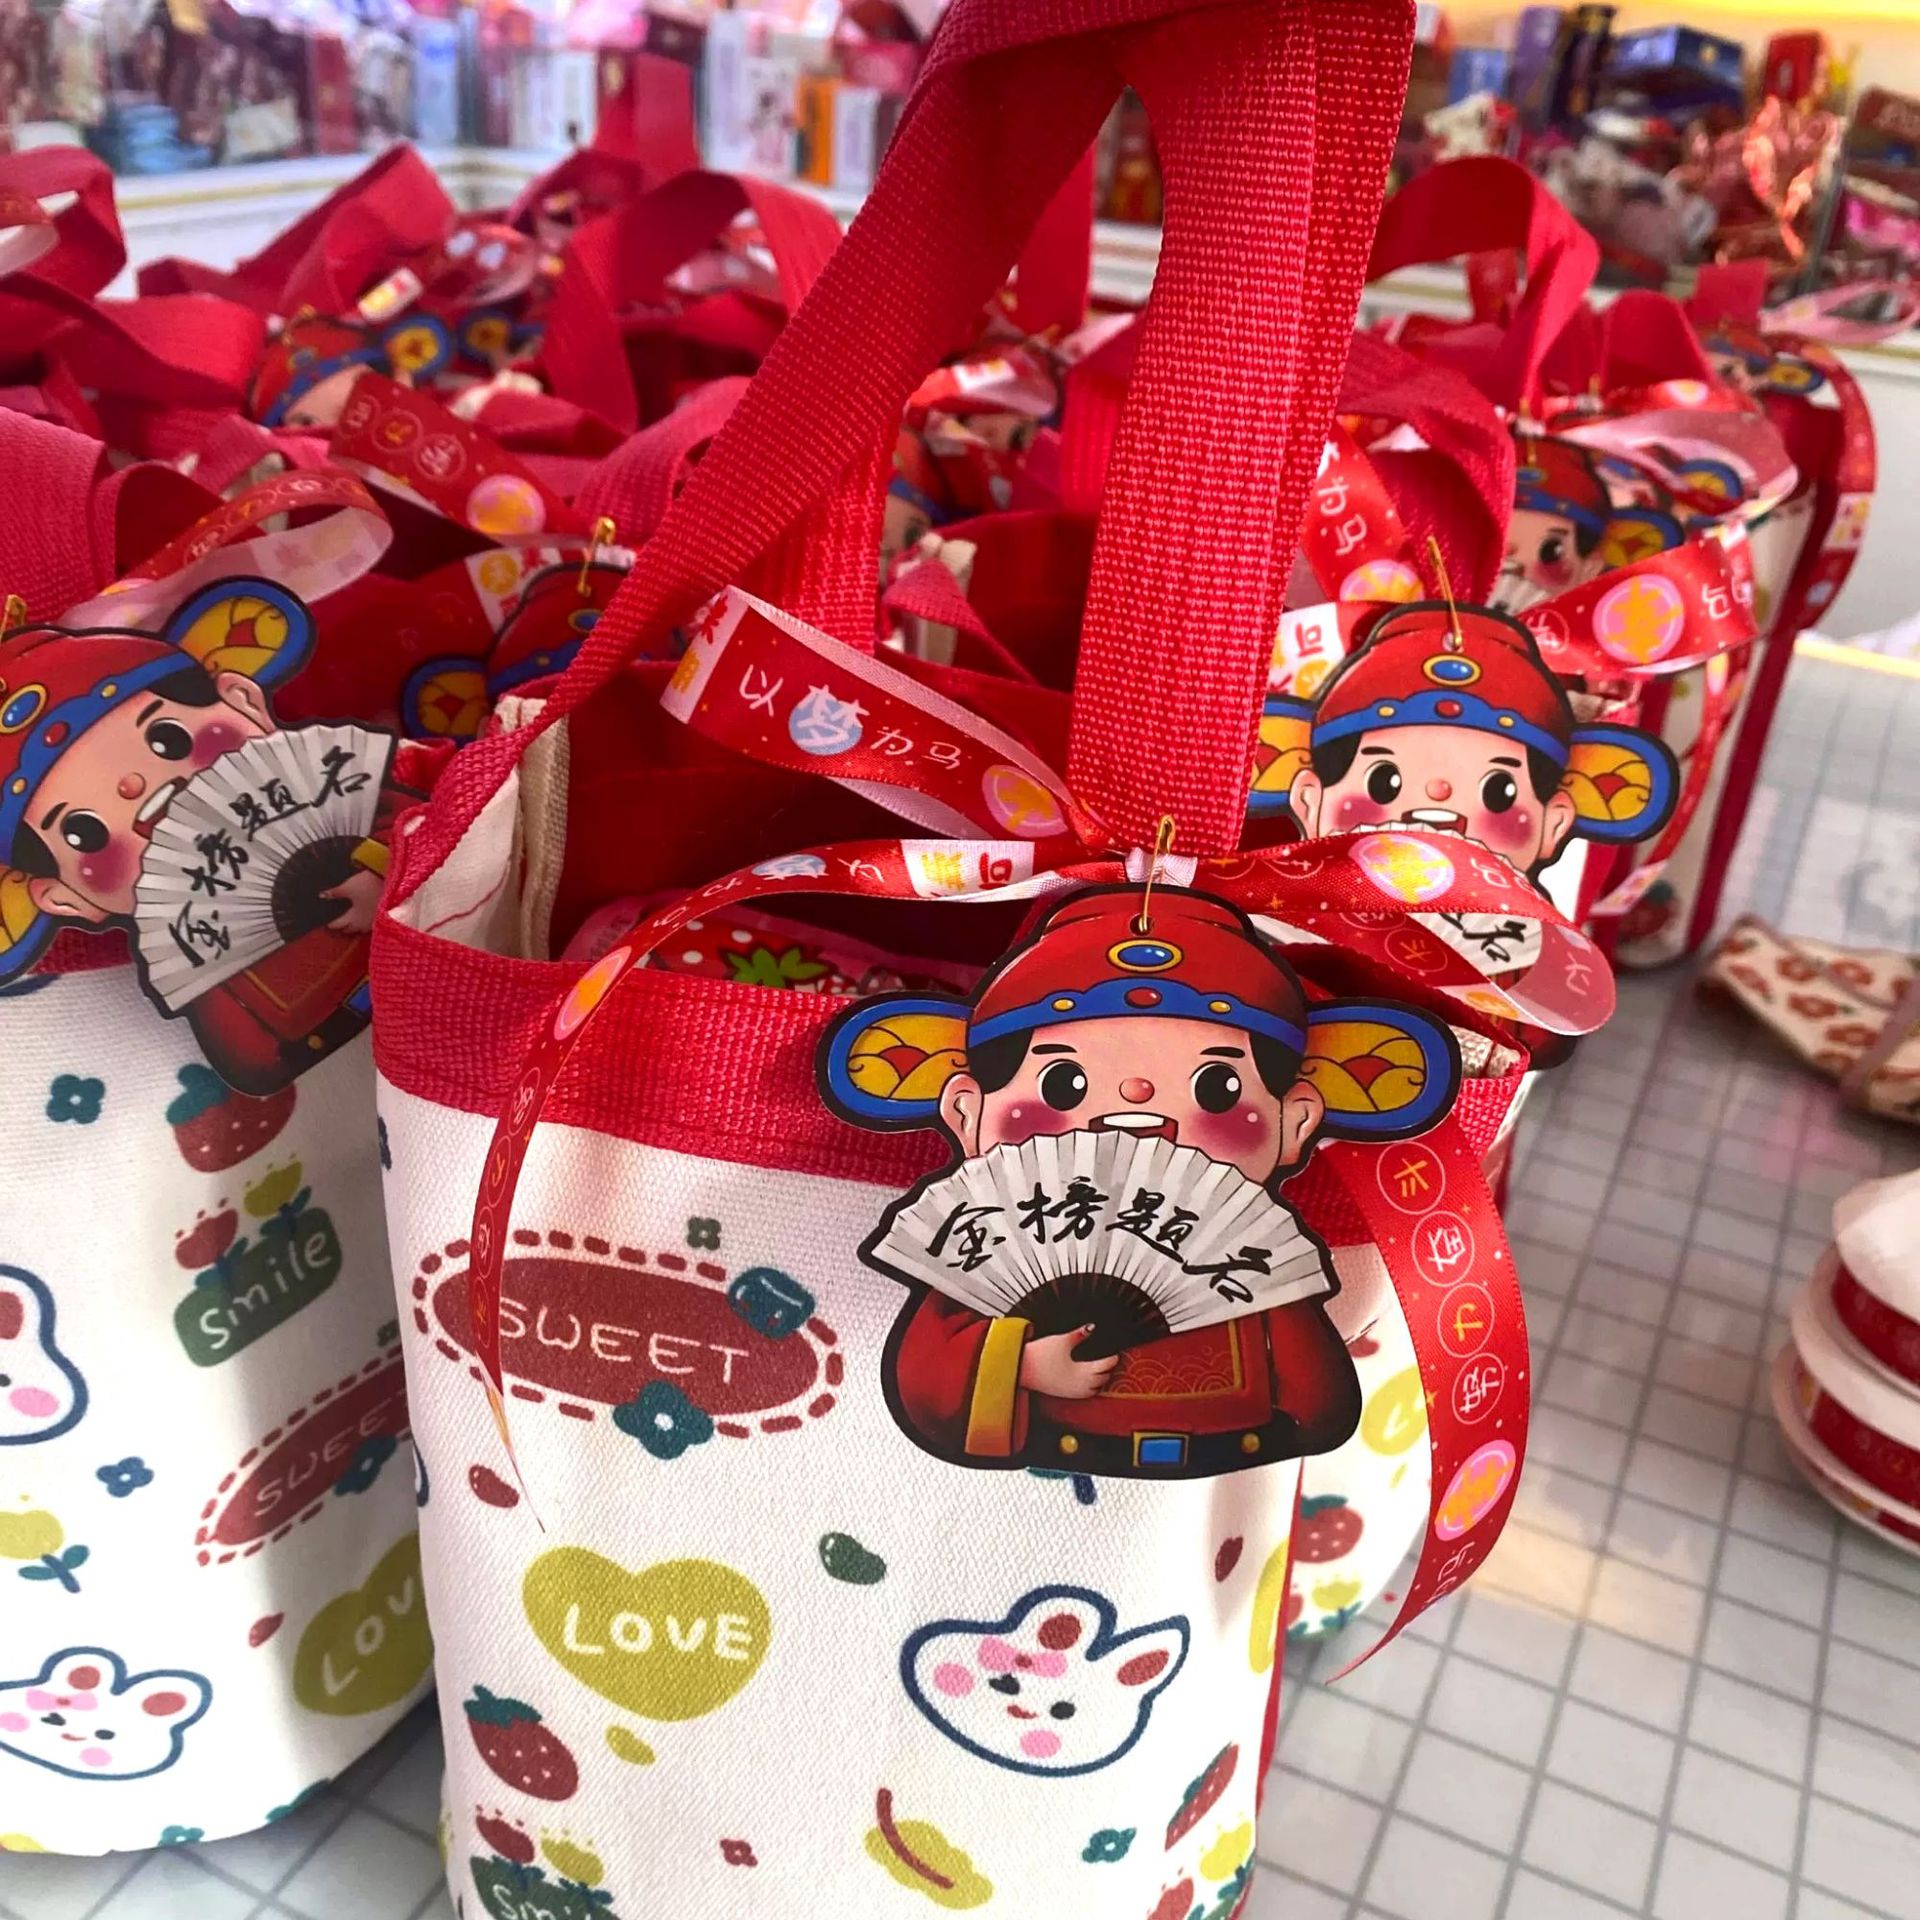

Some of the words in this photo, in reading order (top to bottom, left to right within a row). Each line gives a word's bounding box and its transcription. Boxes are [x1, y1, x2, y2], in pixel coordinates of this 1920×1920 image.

[739, 664, 960, 769] 以梦为马
[168, 745, 372, 968] 金榜题名
[198, 1230, 334, 1350] Smile
[924, 1176, 1272, 1304] 金榜题名
[499, 1295, 749, 1384] SWEET
[255, 1391, 406, 1518] SWEE
[323, 1579, 413, 1697] LOV
[562, 1602, 753, 1662] LOVE
